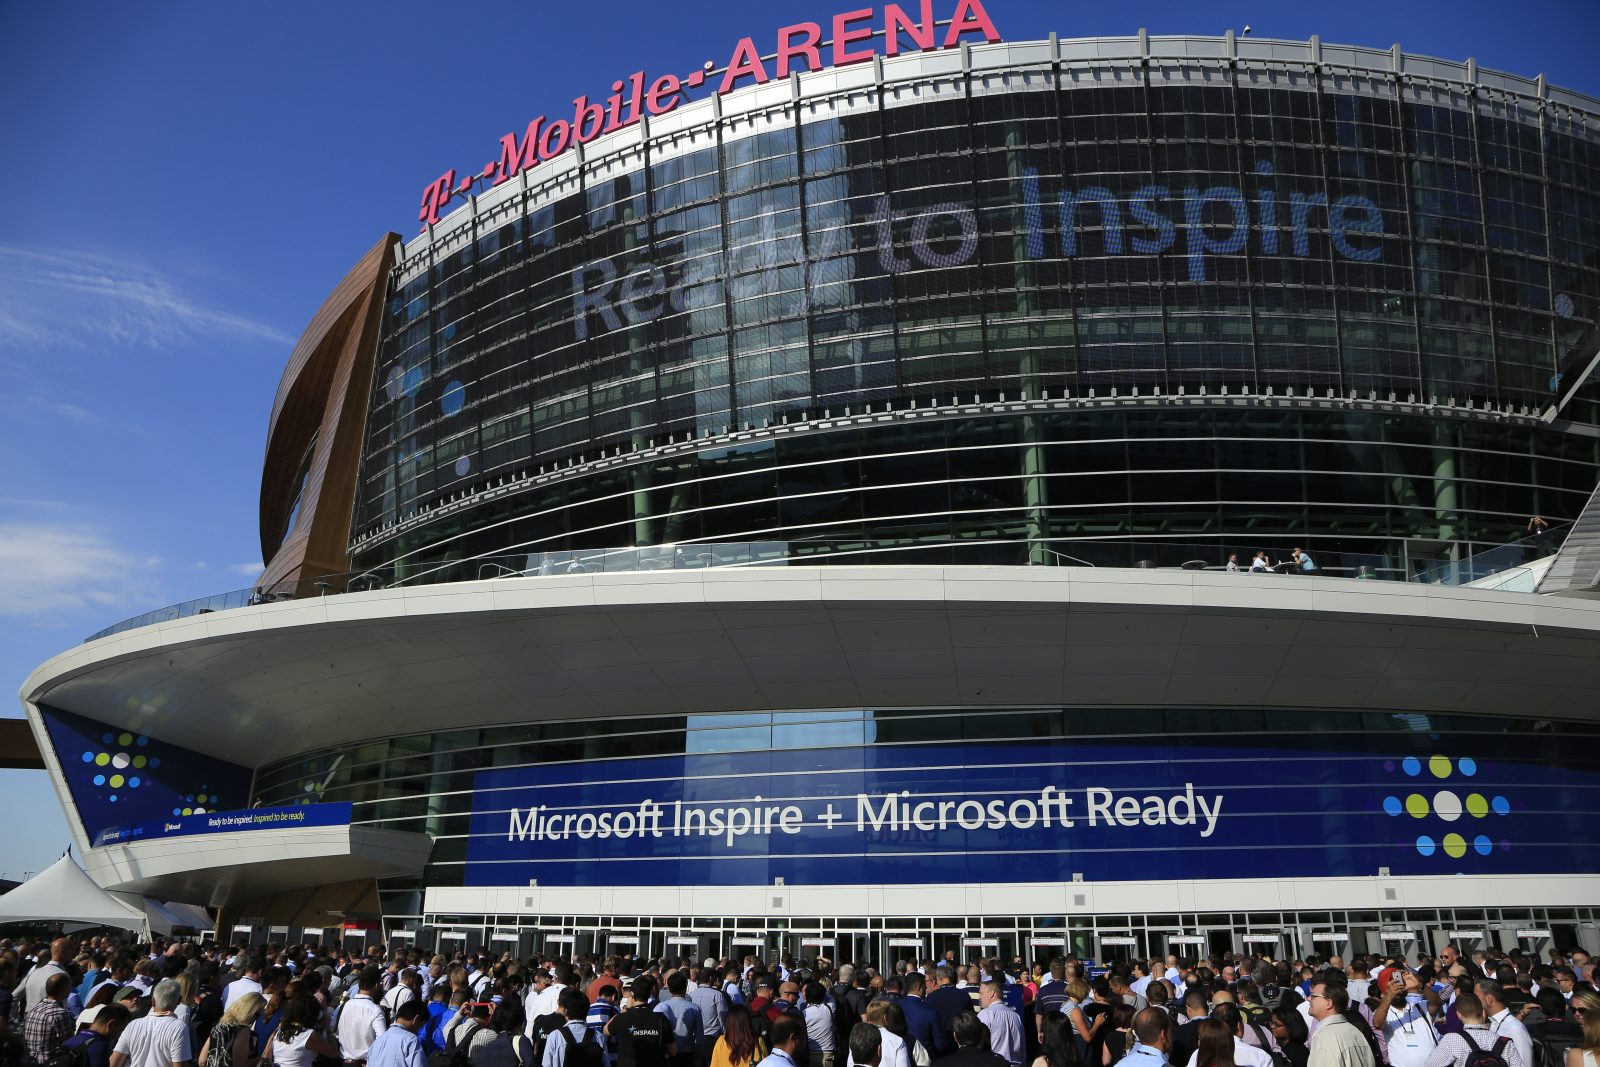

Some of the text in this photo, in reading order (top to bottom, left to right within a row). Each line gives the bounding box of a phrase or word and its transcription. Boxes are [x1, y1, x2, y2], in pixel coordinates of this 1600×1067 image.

[718, 0, 1001, 96] ARENA
[866, 194, 979, 276] to
[1022, 160, 1385, 284] Inspire
[208, 817, 221, 828] Ready
[507, 798, 664, 842] Microsoft
[673, 795, 802, 847] Inspire
[856, 785, 1075, 833] Microsoft
[1085, 782, 1224, 838] Ready
